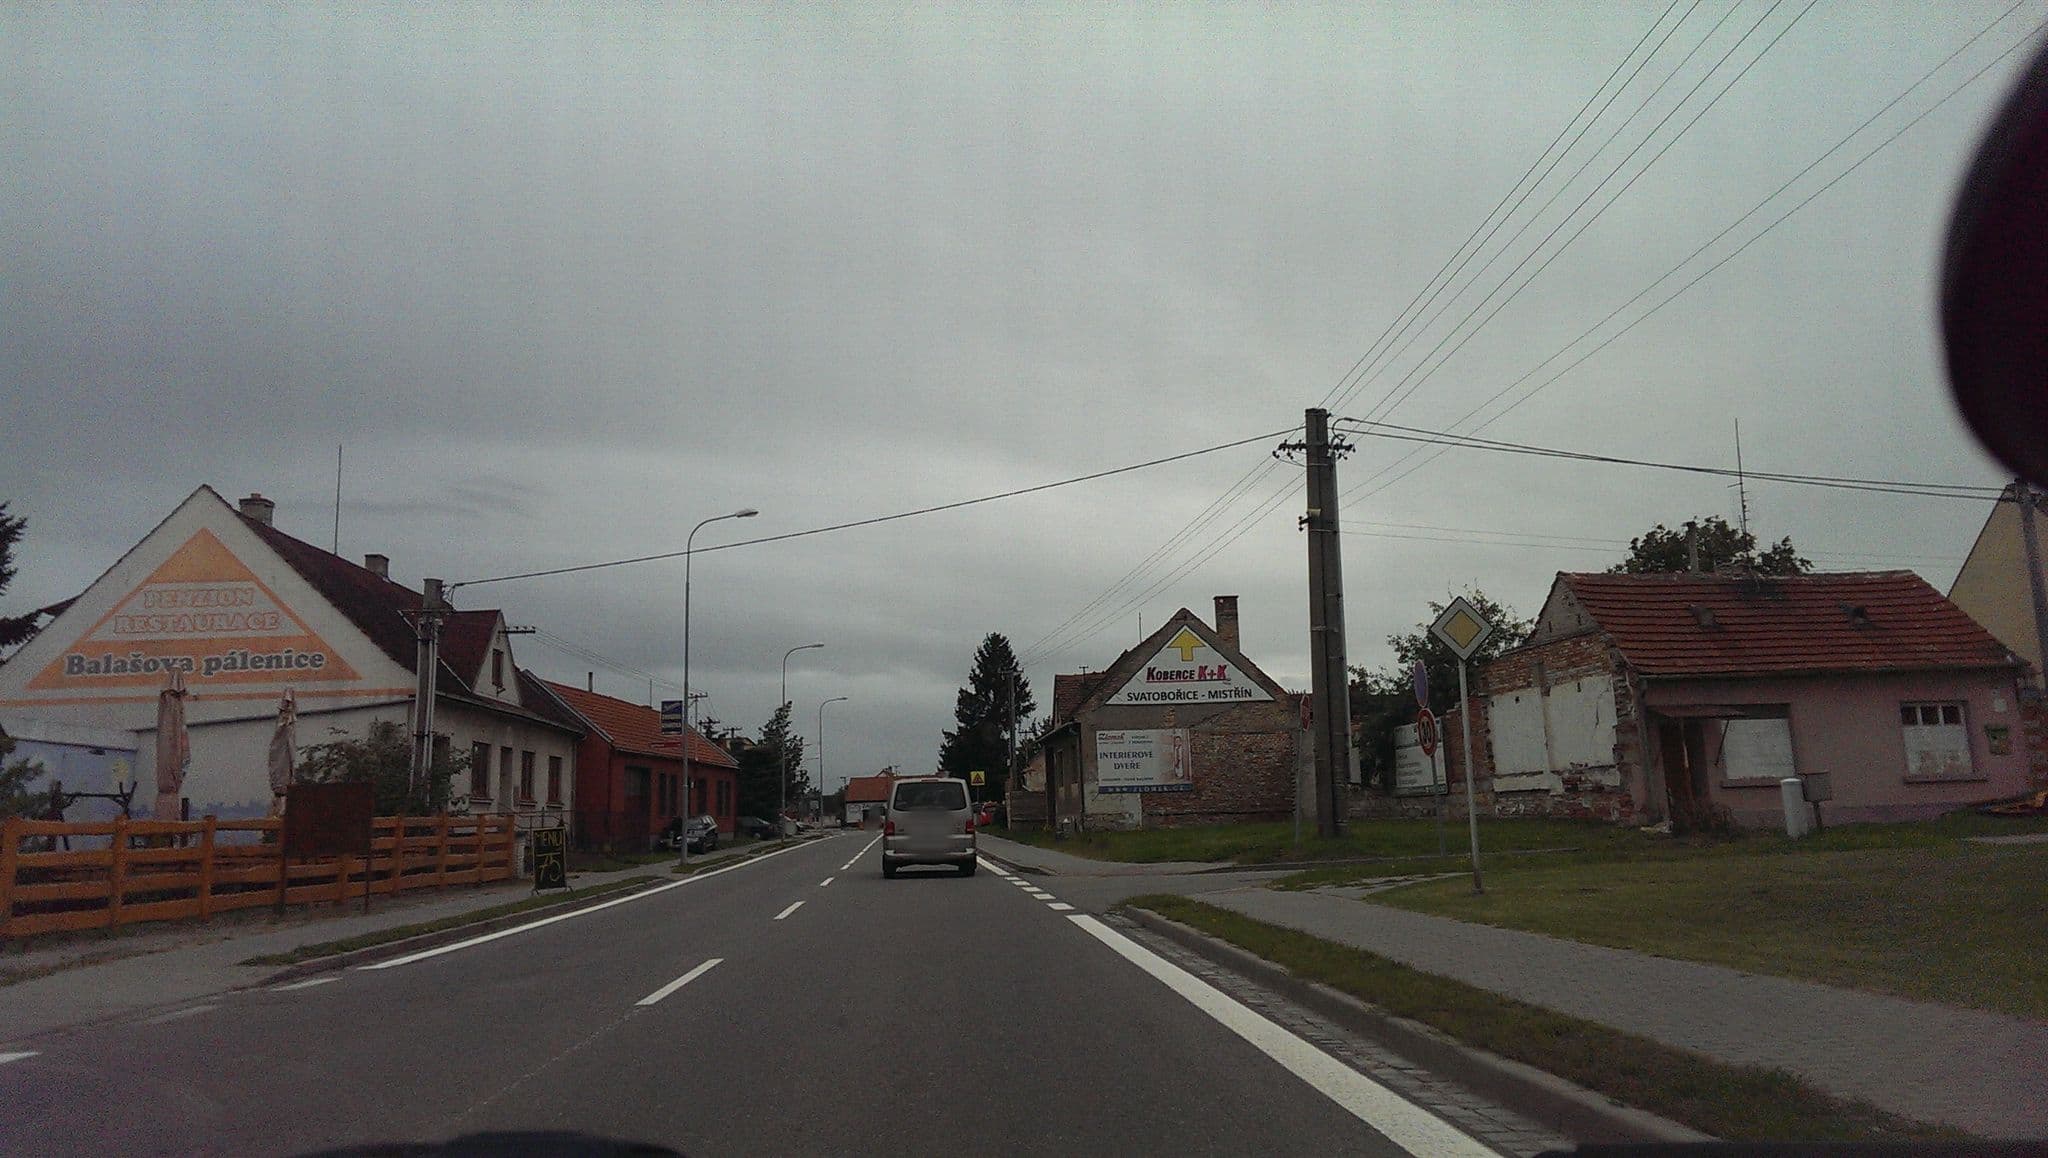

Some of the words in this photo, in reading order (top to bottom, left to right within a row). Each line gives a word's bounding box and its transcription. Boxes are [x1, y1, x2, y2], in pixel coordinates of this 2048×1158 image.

[144, 588, 255, 608] PENZION
[114, 611, 280, 633] RESTAURACE
[65, 652, 194, 676] Balašova
[203, 650, 325, 677] pálenice
[1198, 664, 1227, 680] K+K
[1127, 689, 1199, 701] SVATOBOŘICE
[1208, 687, 1252, 700] MISTŘÍN
